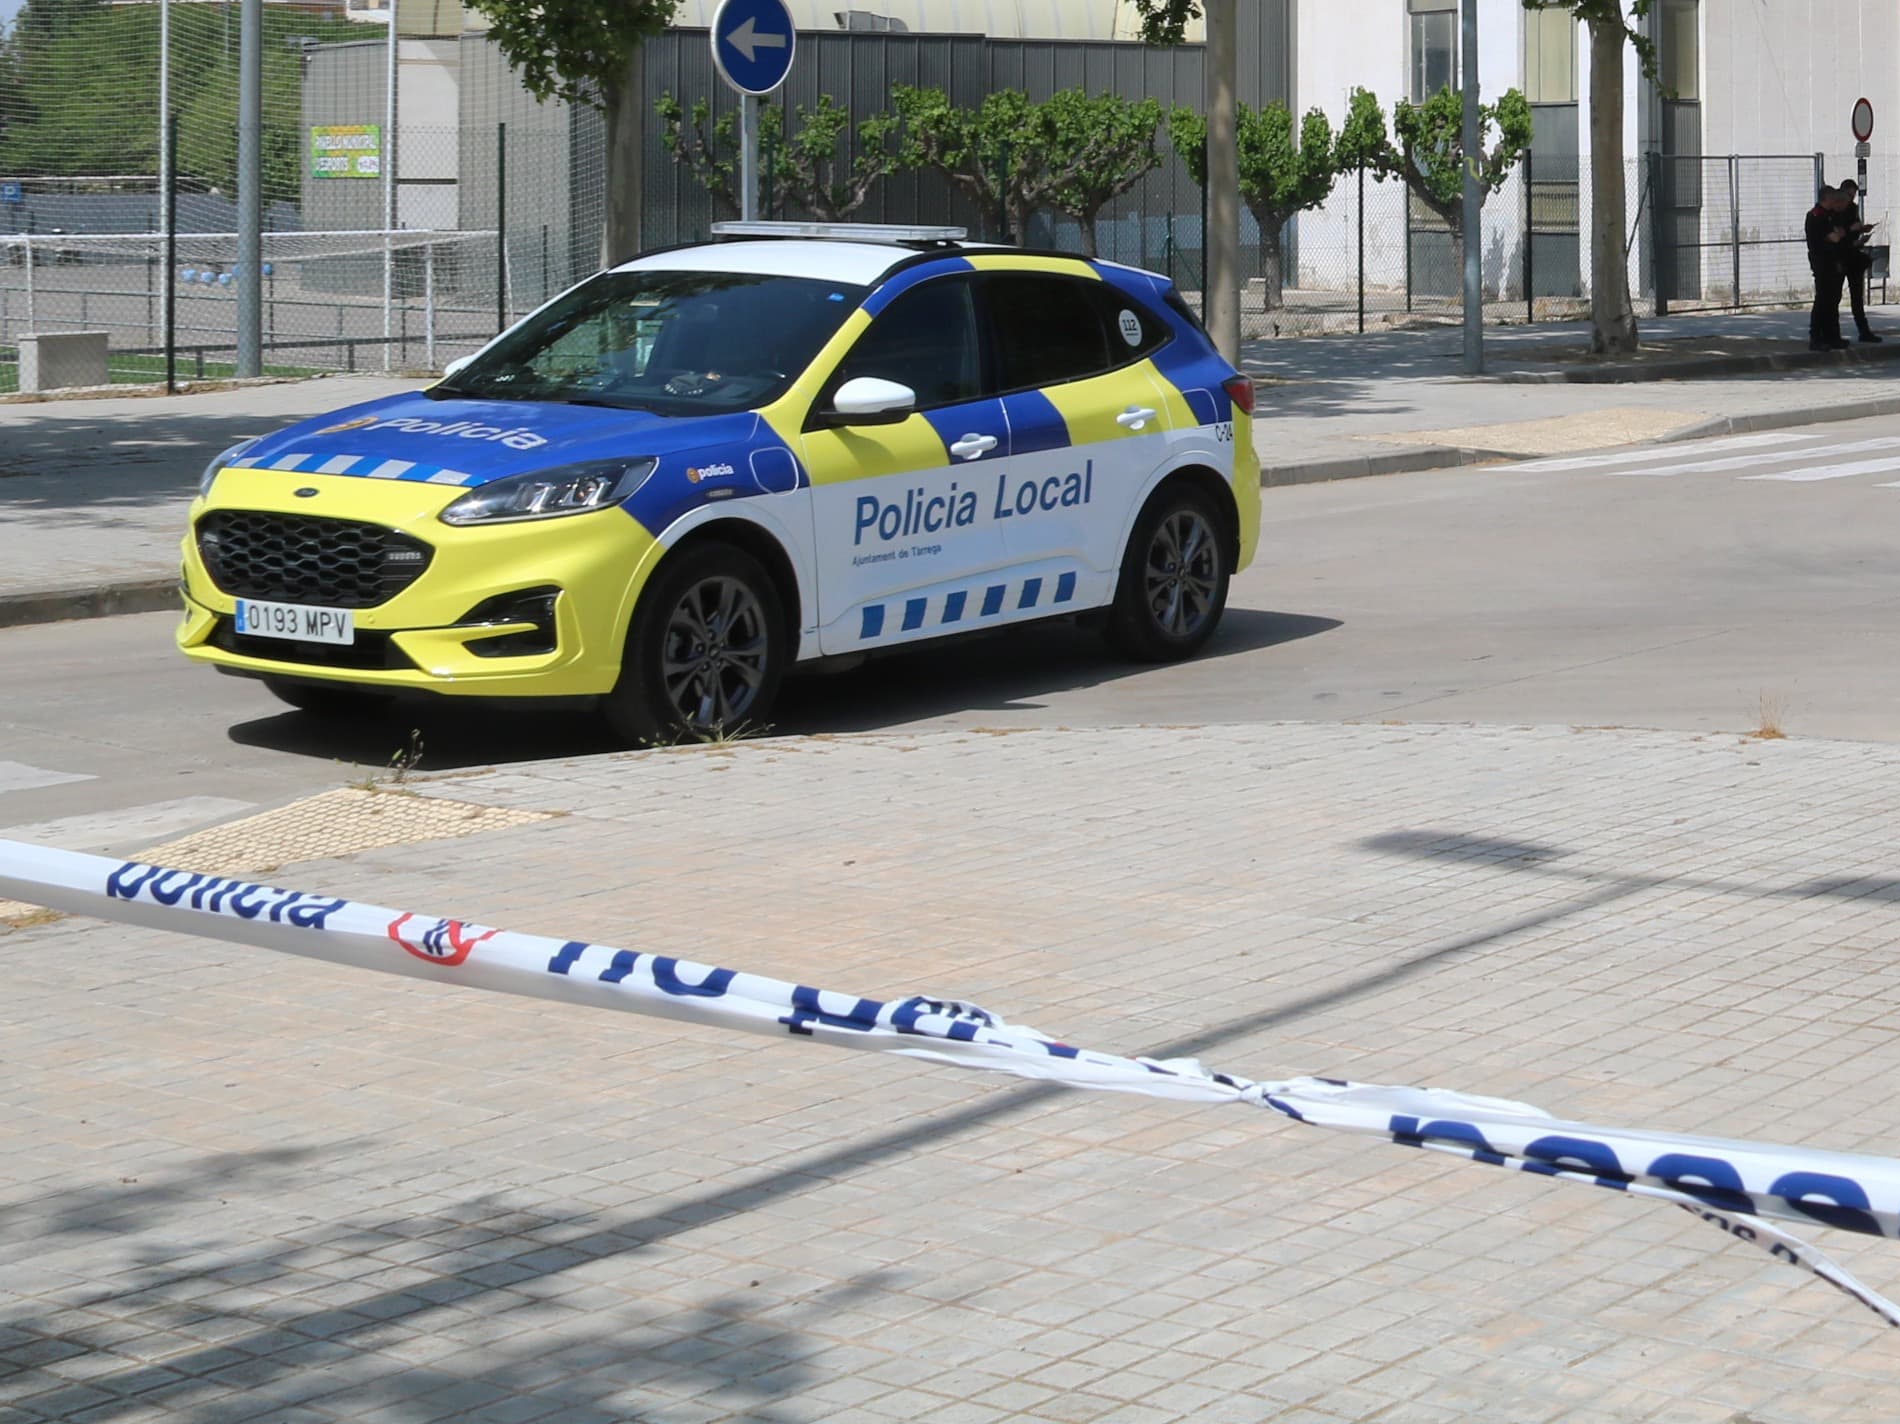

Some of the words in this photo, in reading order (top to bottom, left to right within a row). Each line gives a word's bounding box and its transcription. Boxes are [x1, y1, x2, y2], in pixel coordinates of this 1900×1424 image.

[1122, 319, 1138, 332] 112
[364, 417, 548, 451] Policia
[698, 463, 735, 481] policia
[853, 482, 978, 546] Policia
[993, 459, 1093, 520] Local
[852, 550, 896, 567] Ajuntament
[898, 549, 909, 559] de
[249, 604, 298, 634] 0193
[306, 609, 346, 639] MPV
